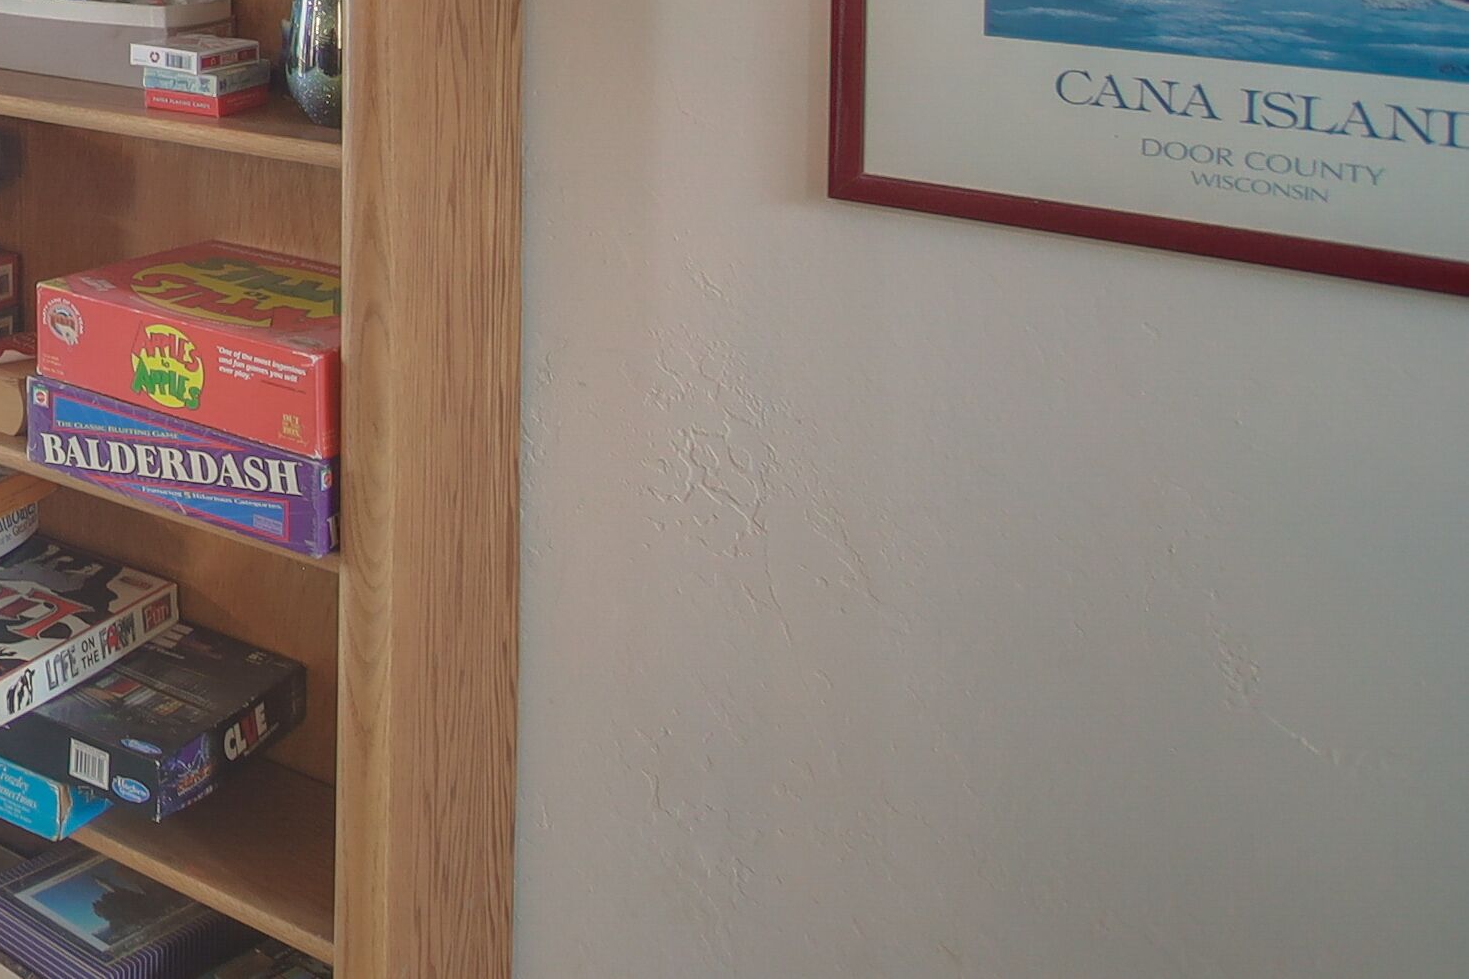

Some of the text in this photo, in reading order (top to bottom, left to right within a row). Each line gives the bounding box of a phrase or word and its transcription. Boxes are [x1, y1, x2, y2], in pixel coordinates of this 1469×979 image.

[1055, 68, 1222, 122] CANA
[1140, 137, 1386, 187] DOOR COUNTY
[1191, 170, 1330, 204] WISCONSIN
[131, 320, 199, 372] APPLES
[161, 358, 170, 368] to
[241, 352, 253, 362] the
[253, 356, 272, 367] most
[131, 358, 201, 411] APPLES
[218, 356, 299, 383] and fun games you will
[56, 420, 180, 441] THE CLASSIC BLUFFING GAME
[40, 432, 303, 497] BALDERDASH
[141, 486, 182, 498] Featuring
[192, 492, 232, 505] Hilarious
[233, 497, 284, 510] Categories
[82, 637, 95, 652] ON
[99, 612, 136, 659] FARM
[45, 644, 79, 691] LIFE
[82, 651, 99, 668] THE
[224, 701, 268, 761] CLUE
